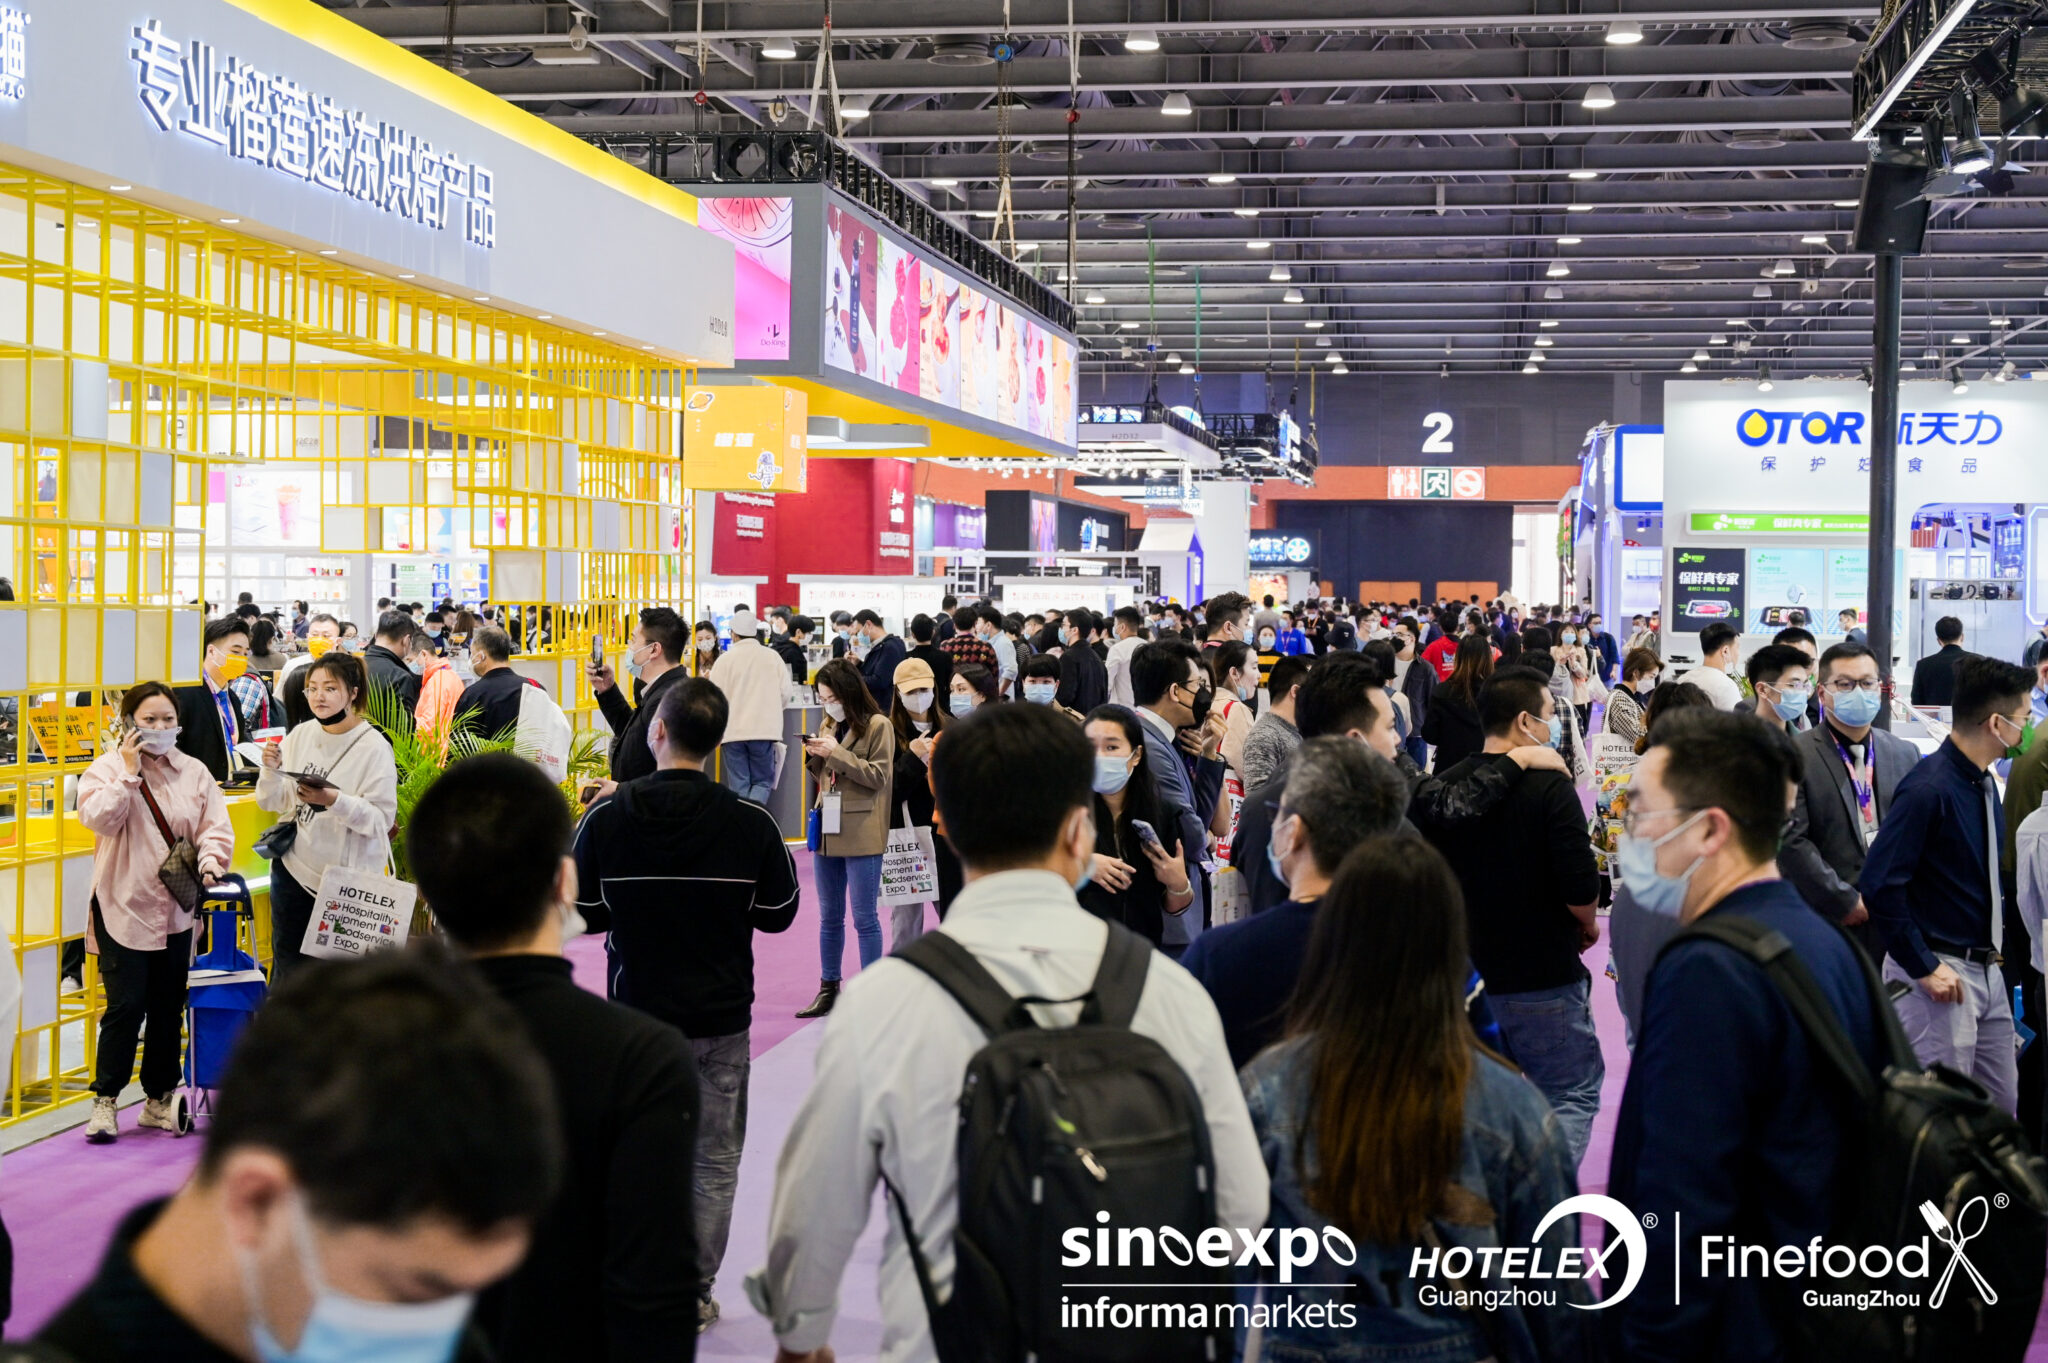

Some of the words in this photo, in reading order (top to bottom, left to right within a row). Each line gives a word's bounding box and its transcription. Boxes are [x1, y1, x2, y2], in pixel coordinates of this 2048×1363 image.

[129, 19, 496, 248] 专业榴莲速冻烘焙产品
[1422, 412, 1455, 453] 2
[1736, 409, 1865, 447] OTOR
[1773, 518, 1823, 529] 保鲜真专家
[1678, 571, 1740, 586] 保鲜真专家
[37, 722, 84, 738] 第二半价
[1602, 744, 1636, 752] HOTELE
[885, 842, 920, 853] TELEX
[339, 886, 396, 909] HOTELEX
[885, 885, 906, 894] Expo
[322, 910, 377, 931] Equipment
[341, 902, 394, 925] Hospitality
[334, 935, 360, 950] Expo
